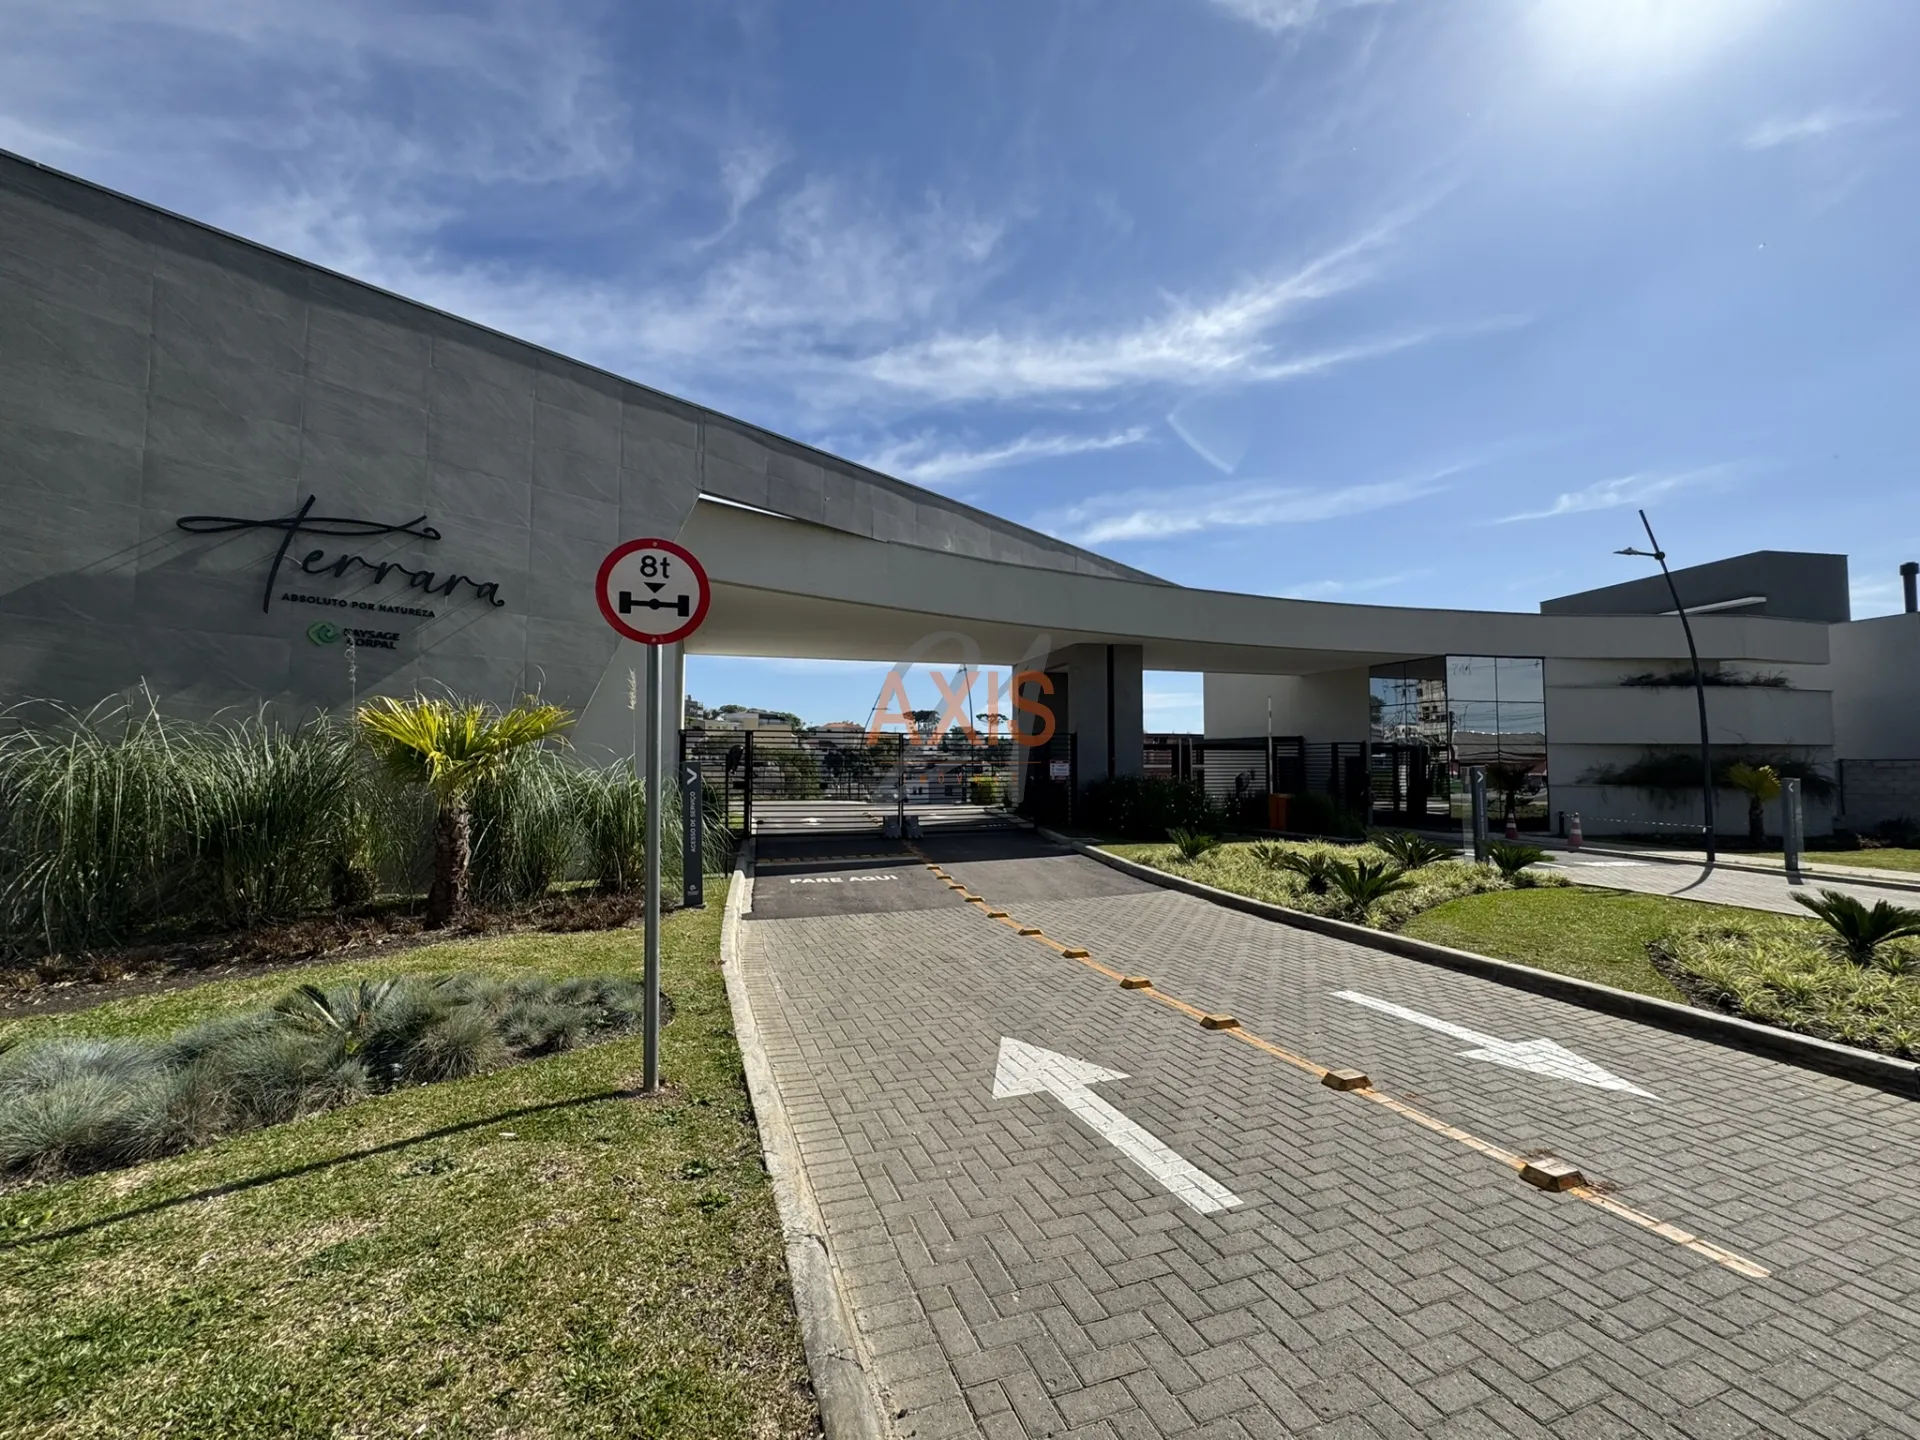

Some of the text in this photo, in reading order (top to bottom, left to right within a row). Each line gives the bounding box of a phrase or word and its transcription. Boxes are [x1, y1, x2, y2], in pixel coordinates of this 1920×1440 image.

[176, 494, 505, 613] Terrara
[640, 555, 671, 579] 8t
[281, 592, 436, 618] ABSOLUTO POR NATUREZA
[690, 819, 696, 827] DE
[848, 874, 898, 882] AQUI
